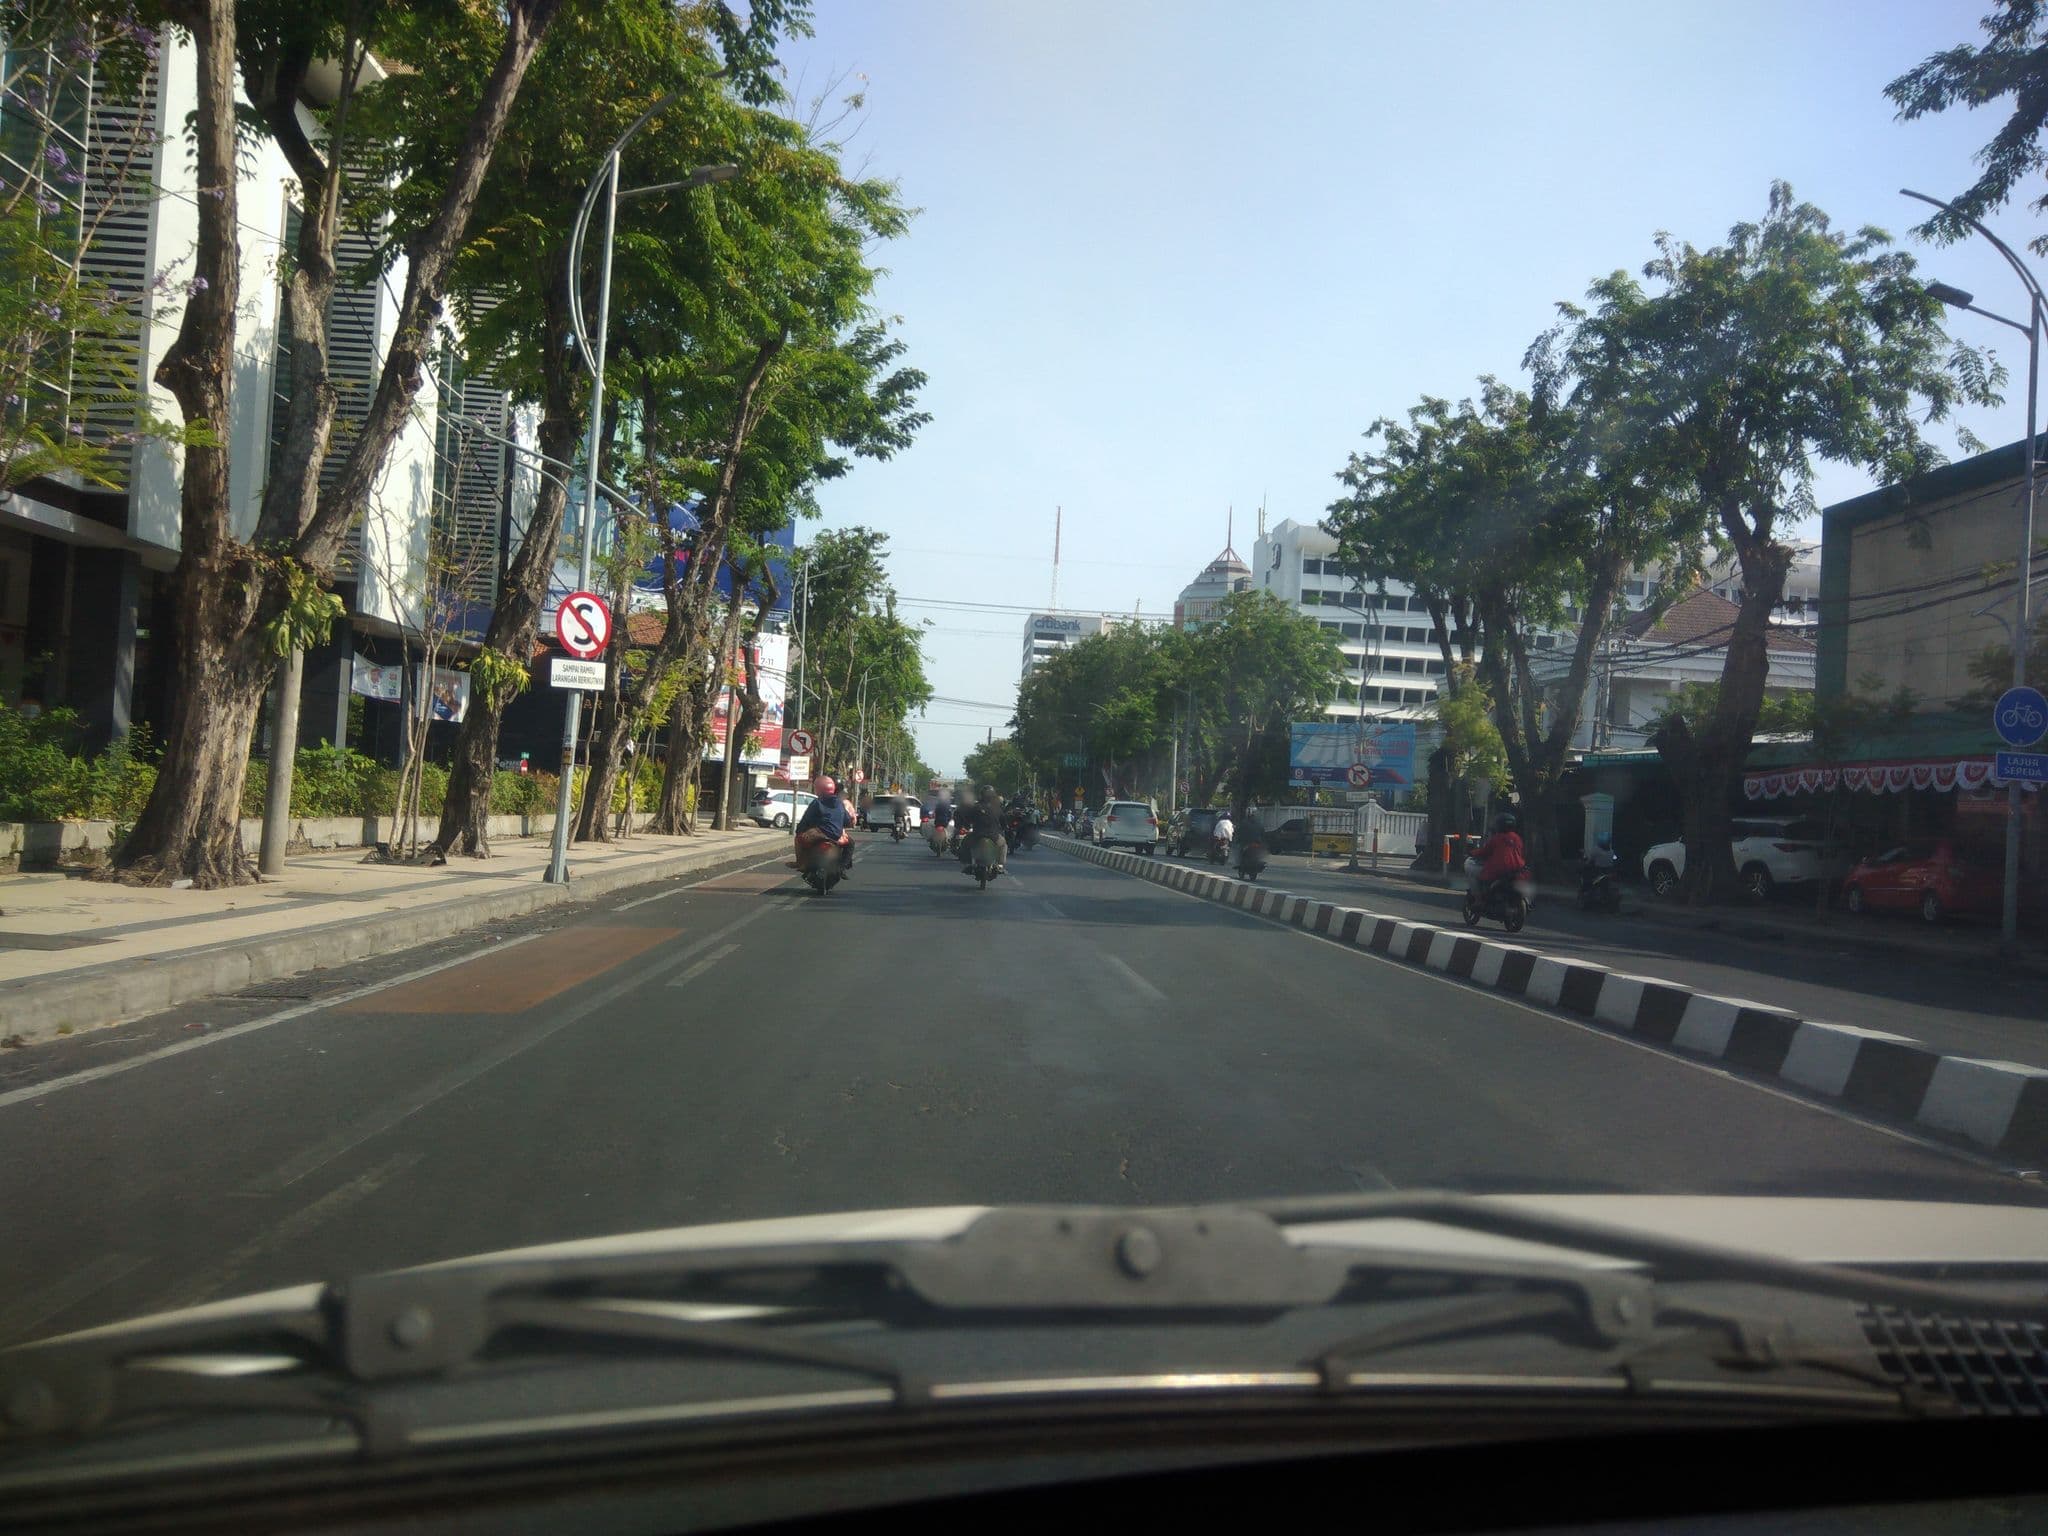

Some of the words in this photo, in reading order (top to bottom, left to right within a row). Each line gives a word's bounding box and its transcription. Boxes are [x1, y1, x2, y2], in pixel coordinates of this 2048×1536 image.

[1034, 616, 1081, 631] citibank
[562, 663, 580, 673] SAMPAI
[580, 665, 596, 675] RAMBU
[552, 674, 578, 684] LARANGAN
[2007, 757, 2039, 767] LAJUR
[2004, 766, 2042, 777] SEPEDA
